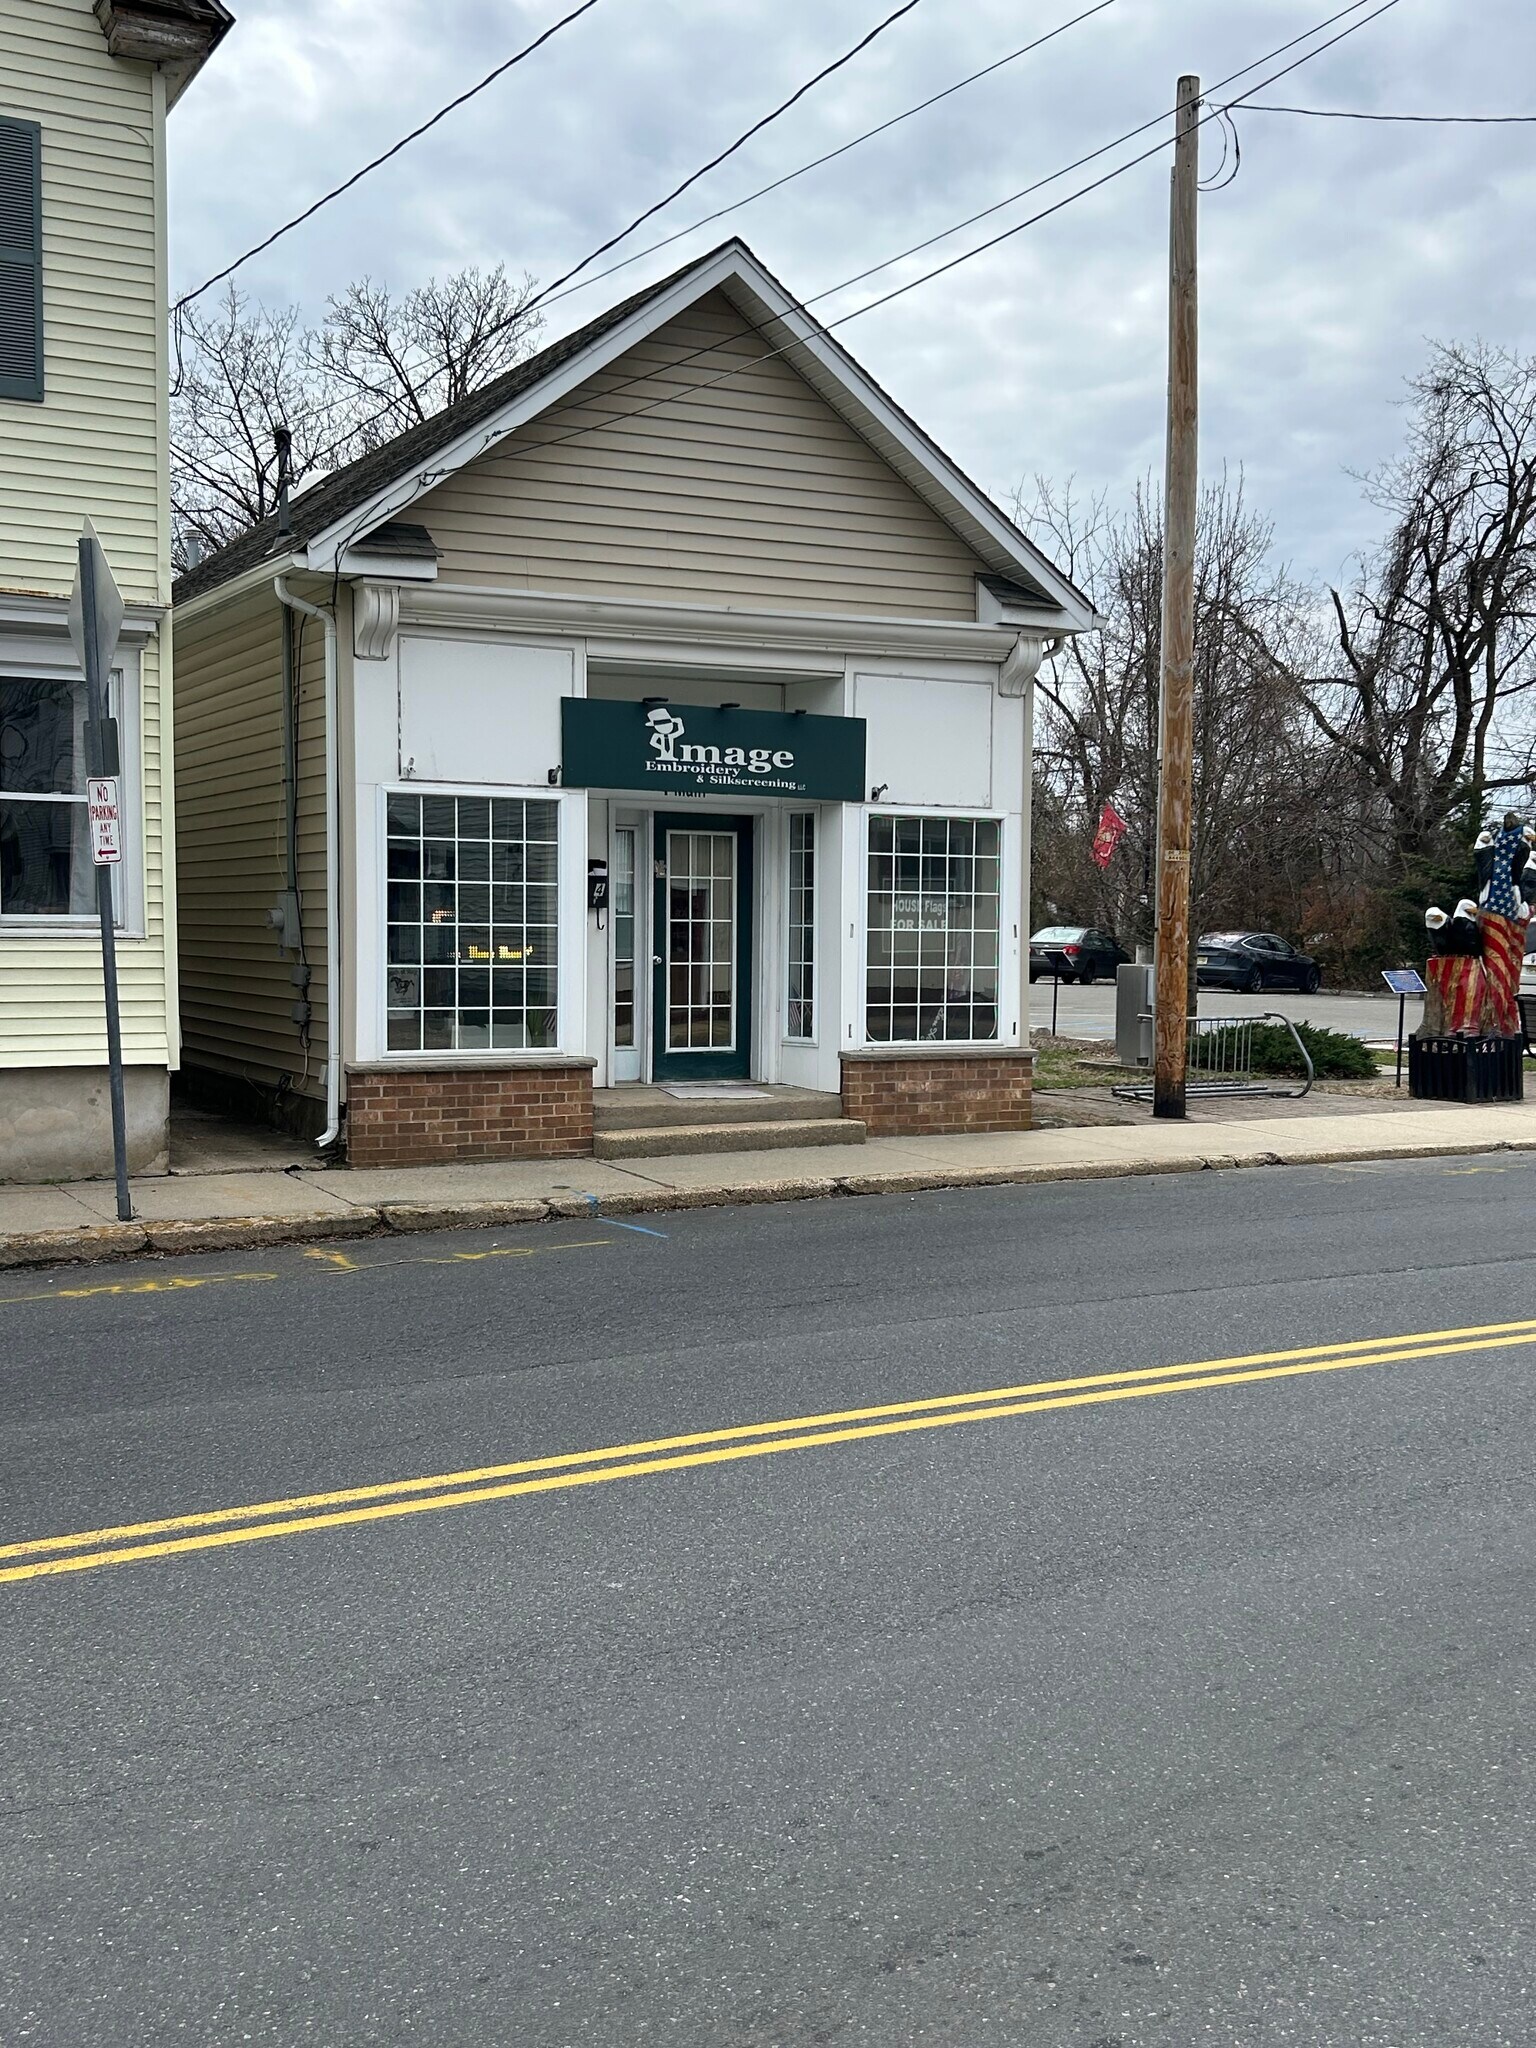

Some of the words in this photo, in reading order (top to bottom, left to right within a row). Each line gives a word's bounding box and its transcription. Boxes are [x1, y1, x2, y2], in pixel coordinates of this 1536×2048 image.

[650, 733, 794, 773] Image
[645, 761, 741, 777] Embroidery
[696, 775, 704, 783] &
[709, 775, 796, 790] Silkscreening
[97, 787, 108, 801] NO
[91, 805, 117, 821] PARKING
[100, 823, 111, 833] ANY
[99, 835, 114, 846] TIME
[924, 900, 948, 916] Flags
[890, 919, 915, 930] FOR
[918, 919, 948, 930] SALE
